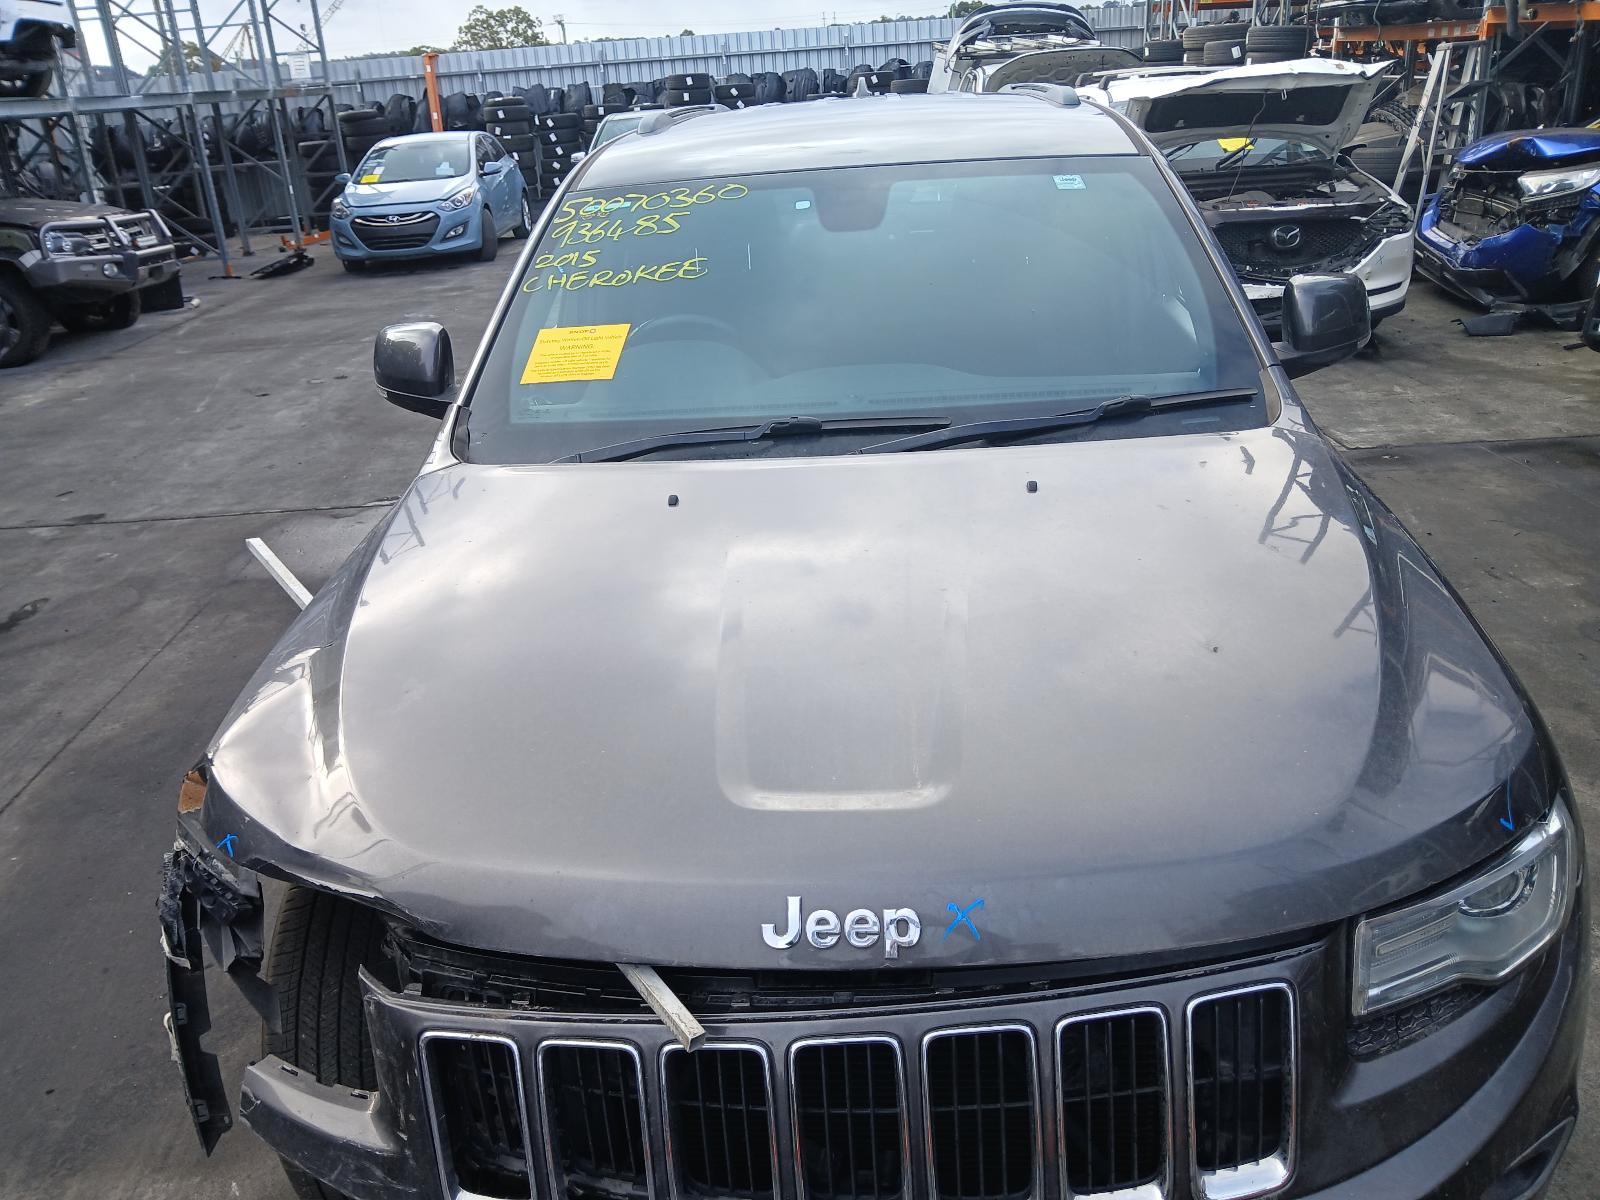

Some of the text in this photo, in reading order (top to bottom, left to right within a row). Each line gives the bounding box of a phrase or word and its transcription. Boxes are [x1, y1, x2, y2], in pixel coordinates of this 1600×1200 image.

[551, 212, 690, 248] 936485
[522, 257, 708, 293] CHEROKEE
[534, 250, 600, 269] 2015
[761, 895, 921, 960] Jeep
